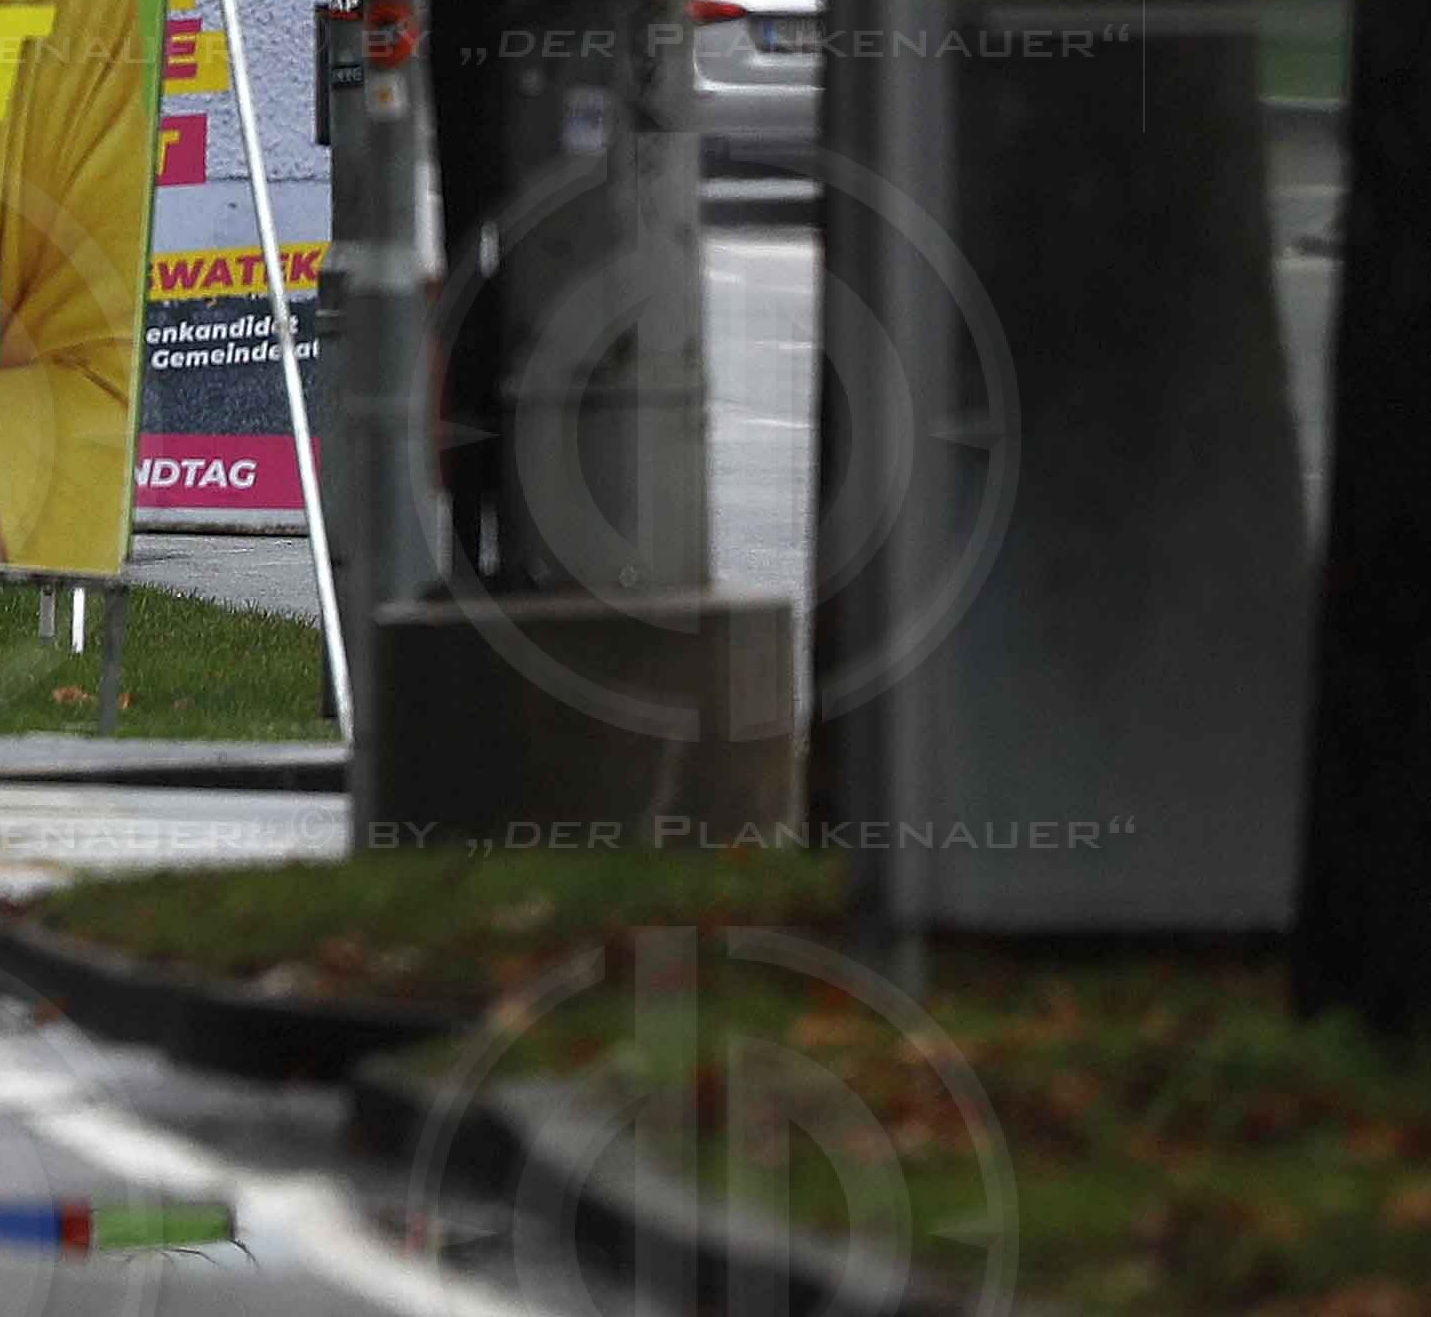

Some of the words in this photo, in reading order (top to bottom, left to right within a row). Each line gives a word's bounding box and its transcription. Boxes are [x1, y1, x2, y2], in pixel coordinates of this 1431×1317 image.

[146, 314, 300, 345] enkandidt
[151, 338, 321, 370] Gemeindeat
[134, 458, 257, 489] NDTAG
